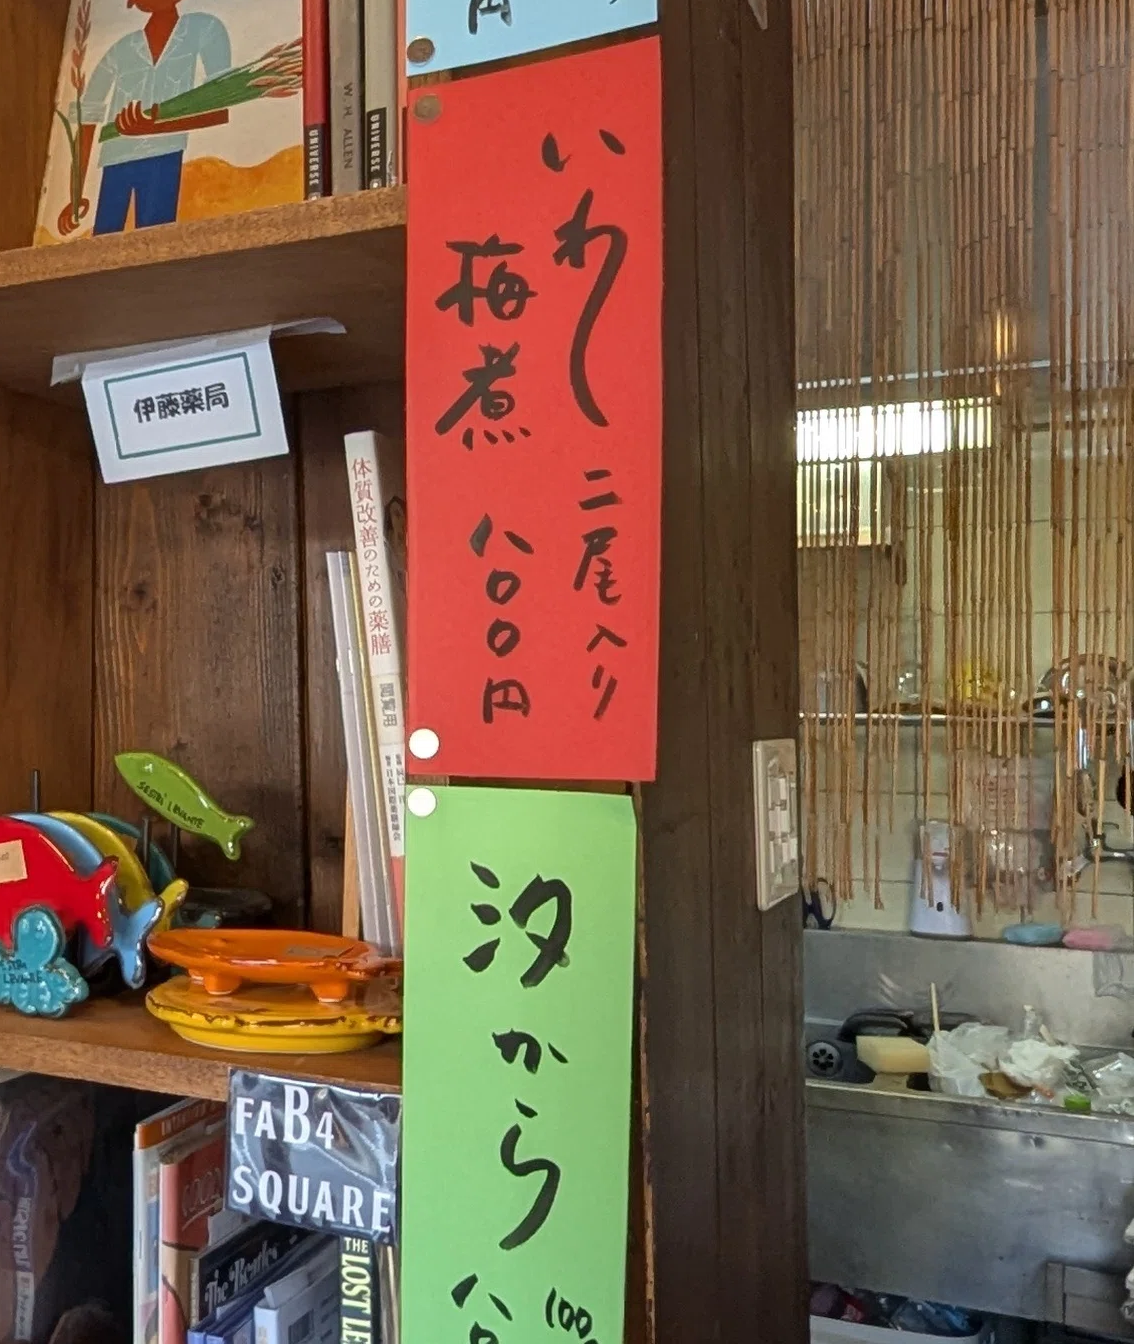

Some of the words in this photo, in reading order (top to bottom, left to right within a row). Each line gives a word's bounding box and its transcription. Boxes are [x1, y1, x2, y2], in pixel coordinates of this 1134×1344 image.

[309, 128, 320, 186] UNIVERSE
[342, 128, 354, 171] ALLEN
[370, 113, 381, 172] UNIVERSE
[541, 129, 627, 428] いわし
[435, 233, 537, 451] 梅煮
[133, 383, 230, 424] 伊藤薬局
[350, 456, 393, 656] 体質改善のための薬膳
[573, 468, 627, 720] 二尾入り
[463, 861, 572, 1252] 汐から
[232, 1165, 393, 1233] SQUARE
[344, 1237, 369, 1254] THE
[341, 1253, 371, 1315] LOST
